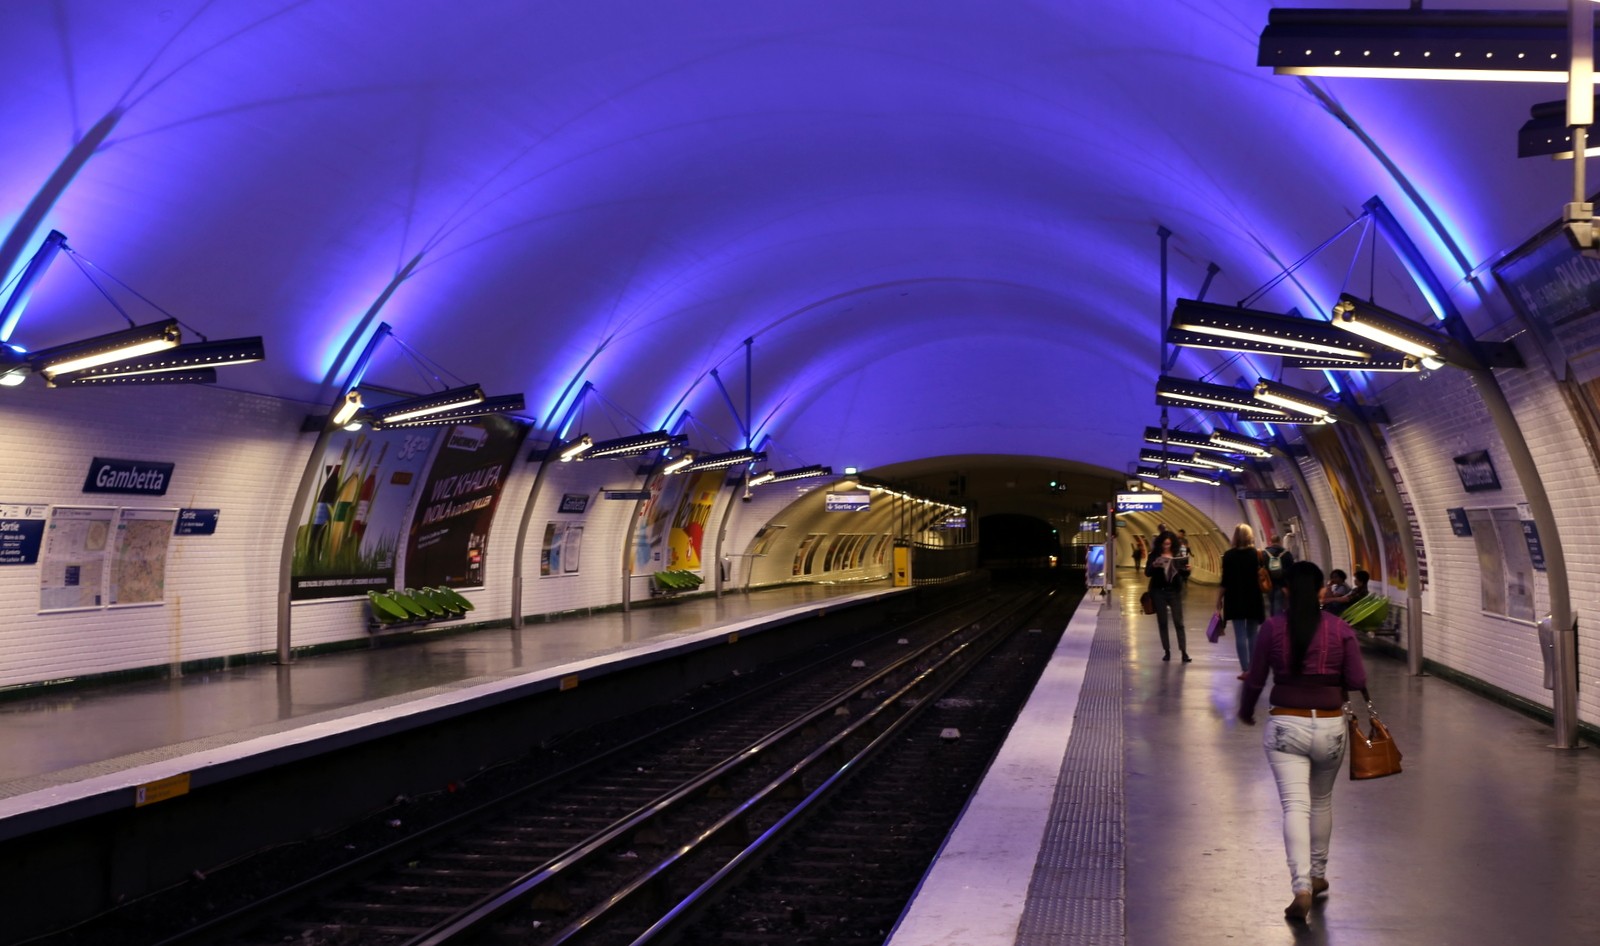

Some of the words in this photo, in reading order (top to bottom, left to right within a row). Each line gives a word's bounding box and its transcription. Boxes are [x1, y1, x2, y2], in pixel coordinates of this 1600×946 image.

[96, 465, 164, 490] Gambetta
[431, 475, 458, 502] WIZ
[453, 464, 502, 497] KHALIFA
[0, 521, 20, 531] Sortie
